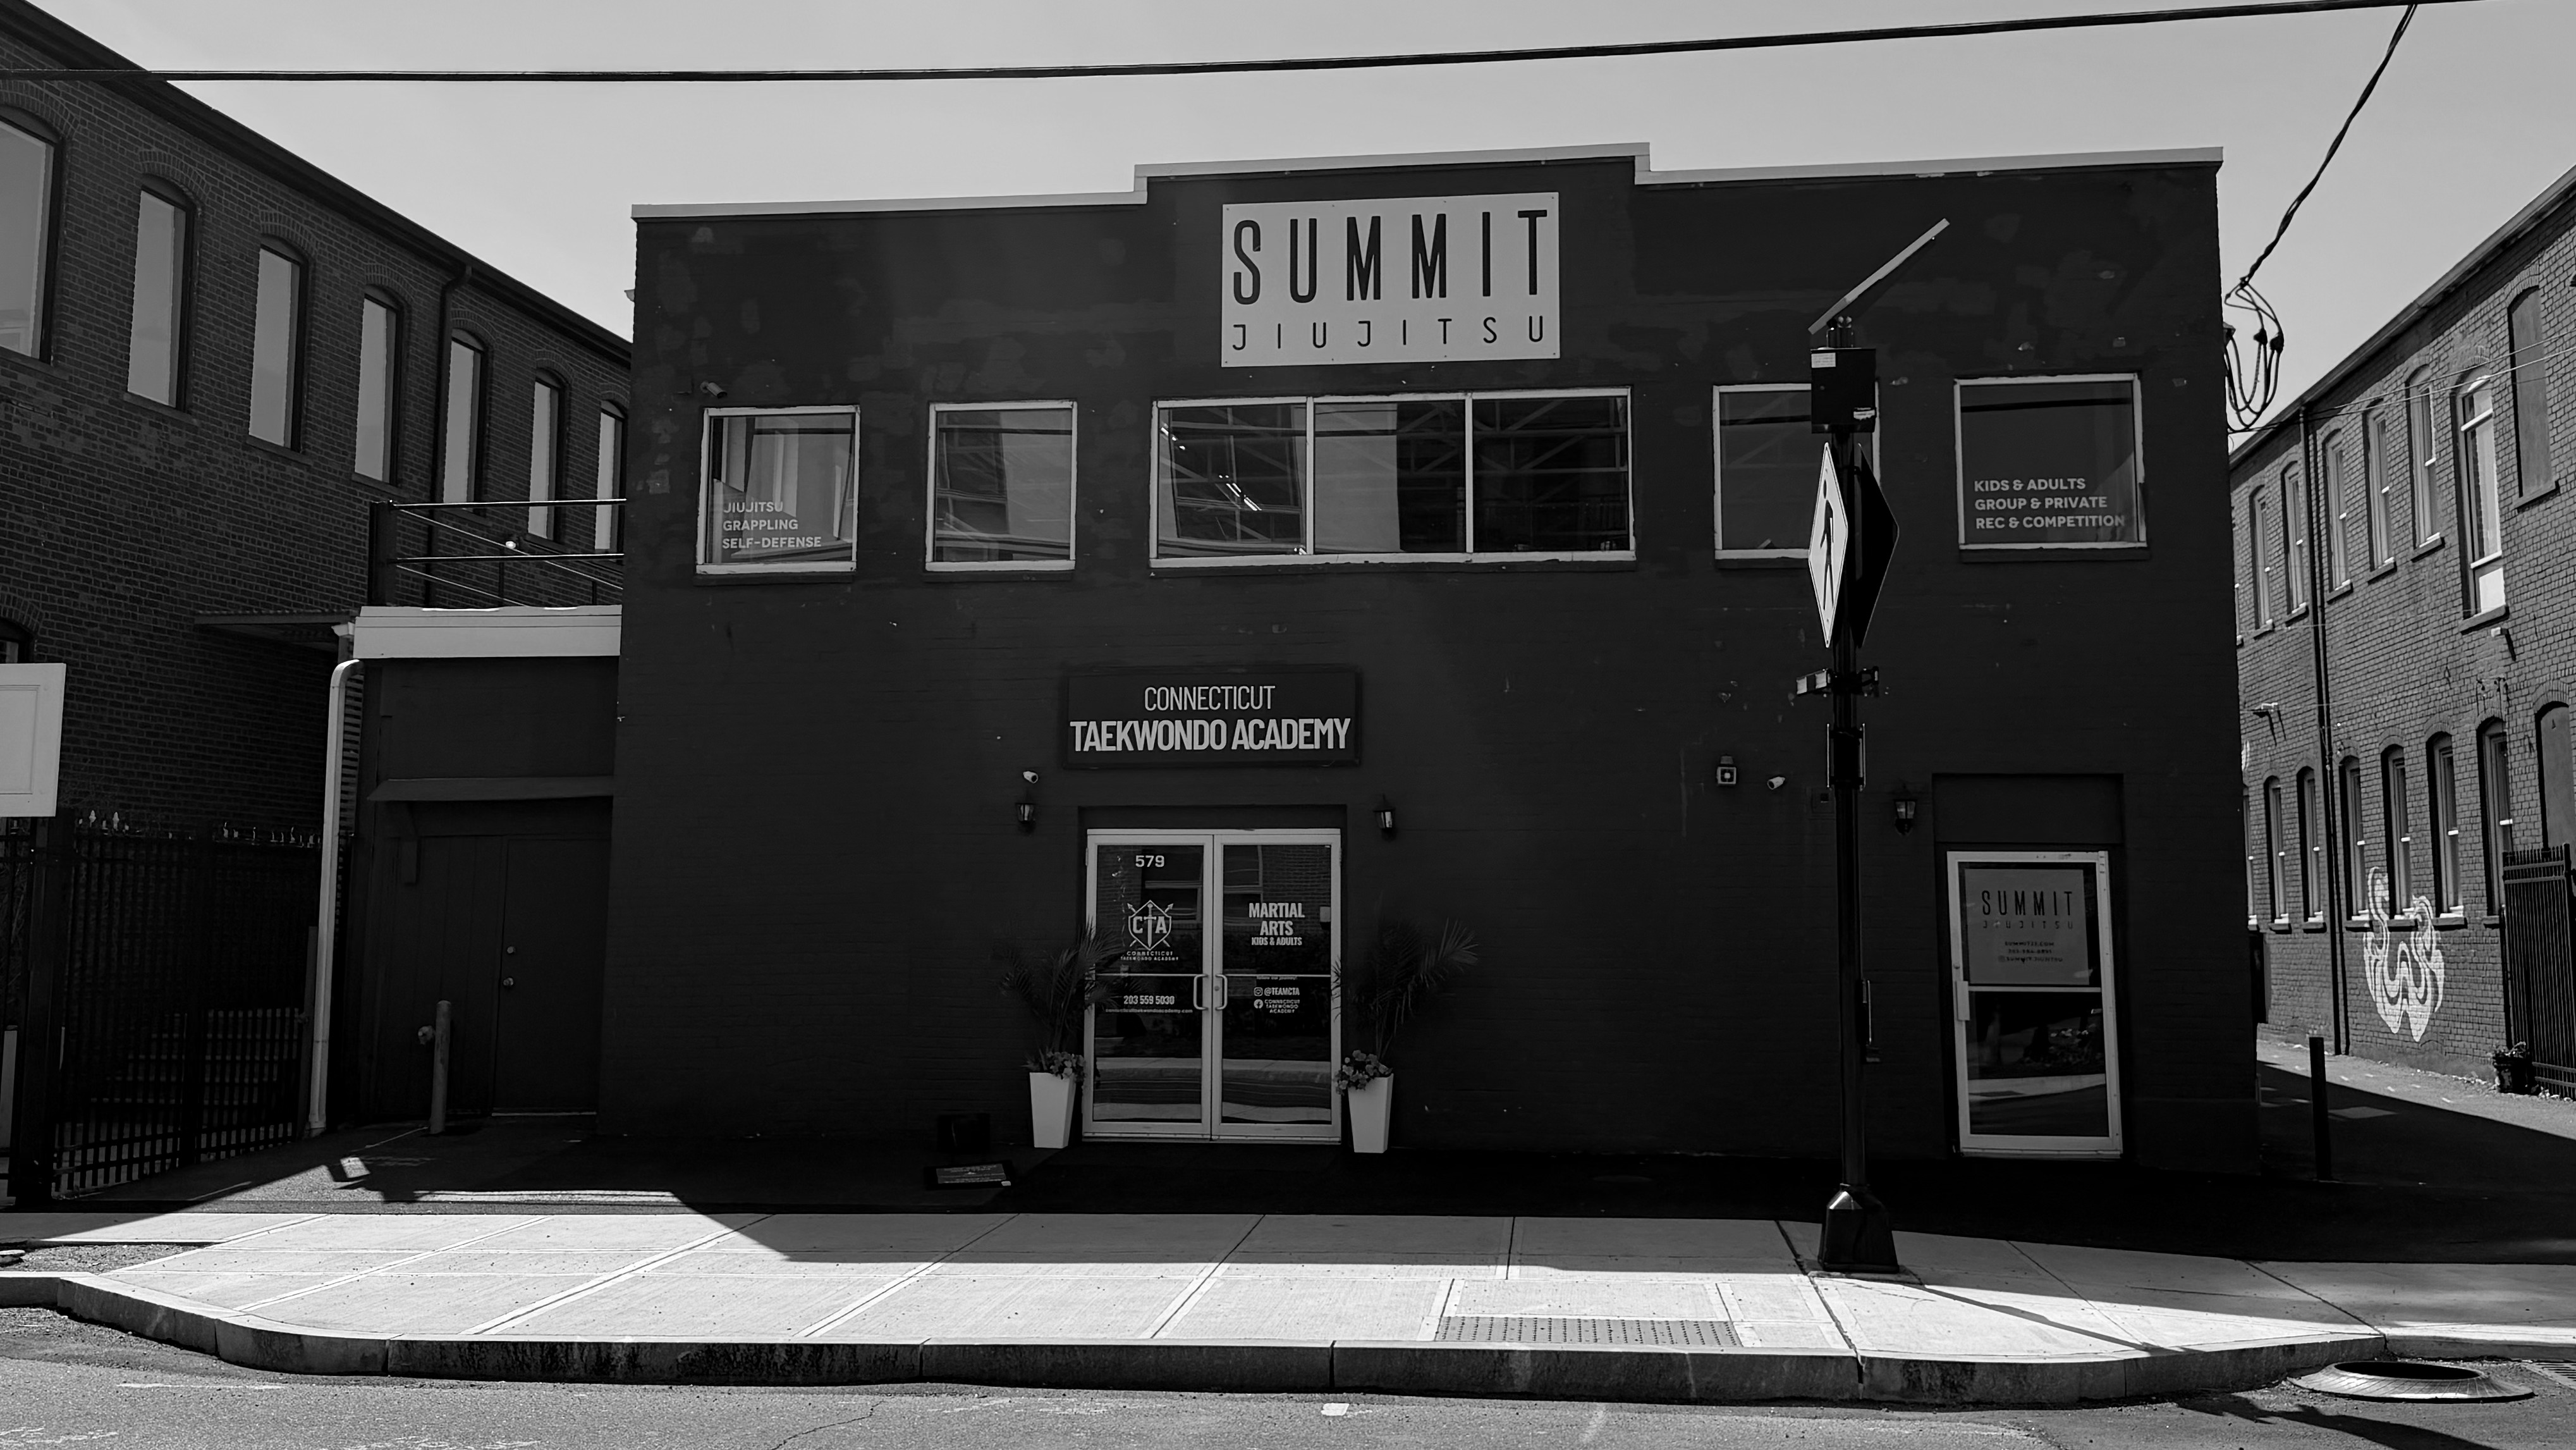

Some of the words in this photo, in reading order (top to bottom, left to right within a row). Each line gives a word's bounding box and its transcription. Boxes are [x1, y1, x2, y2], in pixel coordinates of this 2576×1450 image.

[1233, 209, 1548, 305] SUMMIT
[1232, 316, 1544, 351] JIUJITSU
[1974, 480, 2009, 492] KIDS
[2013, 479, 2024, 491] &
[2027, 478, 2086, 491] ADULTS
[723, 501, 783, 513] JIUJITSU
[1975, 498, 2027, 510] GROUP
[2030, 497, 2041, 509] &
[2045, 496, 2108, 508] PRIVATE
[723, 519, 798, 531] GRAPPLING
[1976, 517, 2005, 529] REC
[2009, 516, 2020, 527] &
[2023, 515, 2125, 528] COMPETITION
[722, 536, 822, 549] SELF-DEFENSE
[1144, 685, 1276, 711] CONNECTICUT
[1070, 719, 1227, 751] TAEKWONDO
[1231, 718, 1351, 750] ACADEMY
[1135, 855, 1165, 868] 579
[1248, 902, 1305, 918] MARTIAL
[1982, 890, 2073, 916] SUMMIT
[1260, 920, 1293, 936] ARTS
[1251, 937, 1268, 946] KIDS
[1269, 937, 1275, 946] &
[1276, 937, 1302, 946] ADULTS
[1264, 987, 1300, 997] @TEAMCTA
[1123, 995, 1138, 1005] 203
[1139, 995, 1154, 1005] 559
[1155, 995, 1175, 1005] 5030
